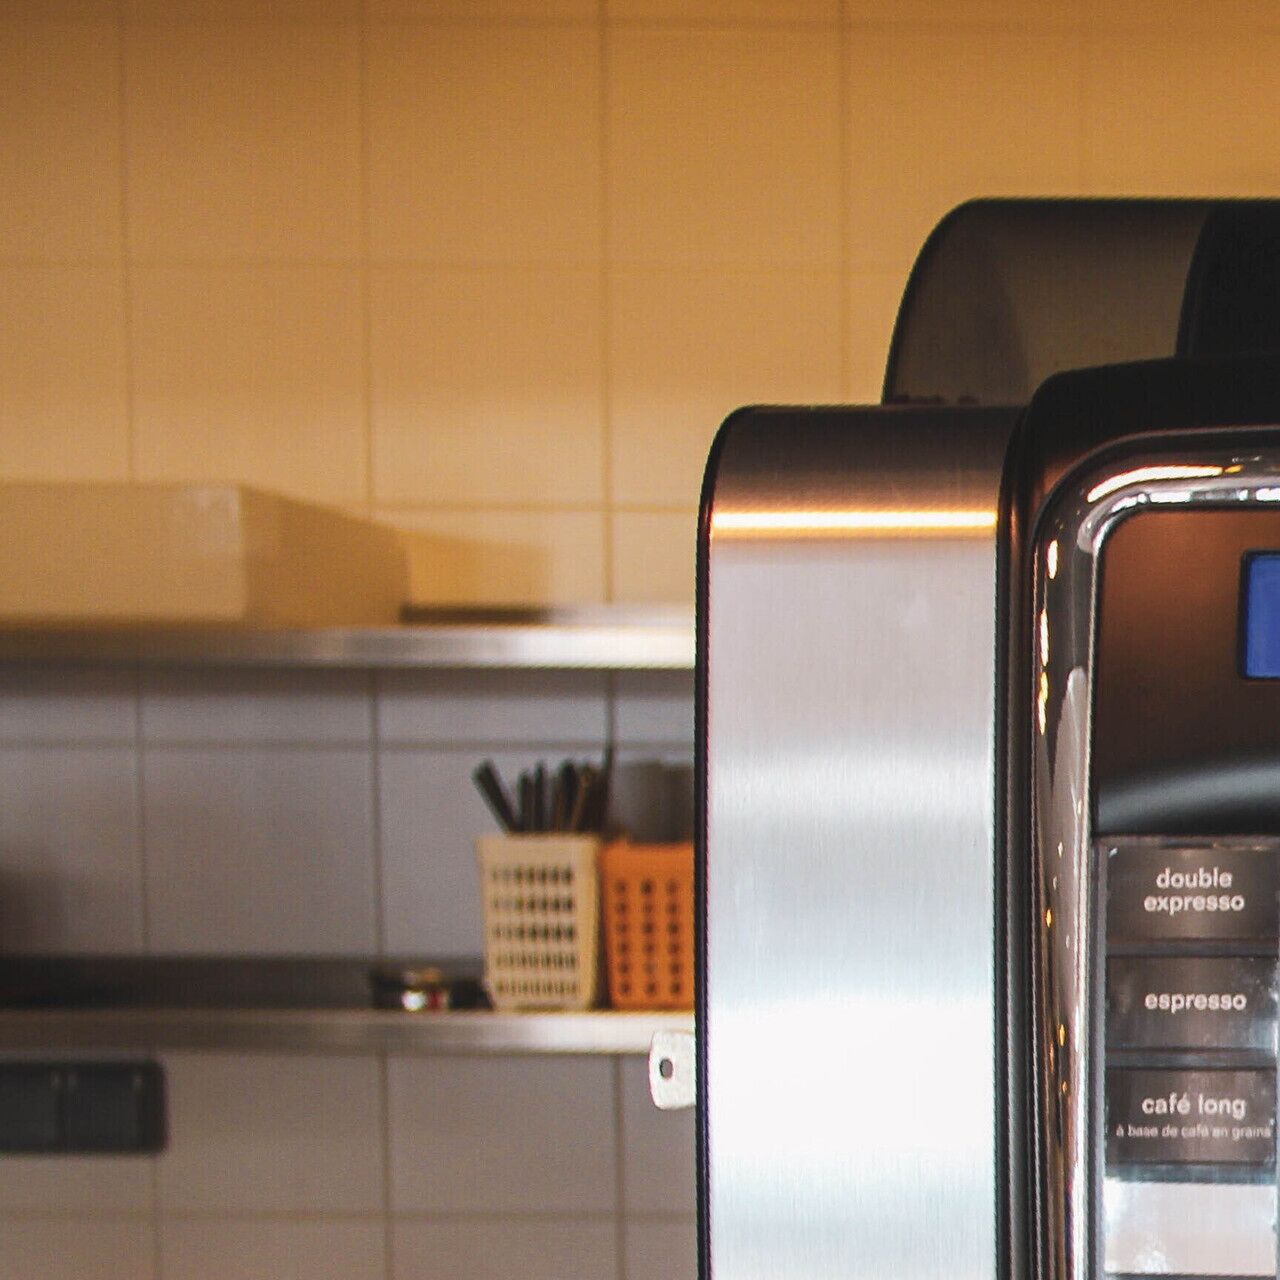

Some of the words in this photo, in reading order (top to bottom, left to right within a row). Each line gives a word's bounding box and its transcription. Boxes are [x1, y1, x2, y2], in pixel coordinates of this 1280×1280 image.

[1155, 867, 1233, 889] double
[1143, 893, 1245, 914] expresso
[1144, 990, 1247, 1013] espresso
[1142, 1091, 1191, 1115] café
[1198, 1092, 1247, 1121] long
[1161, 1123, 1178, 1138] de
